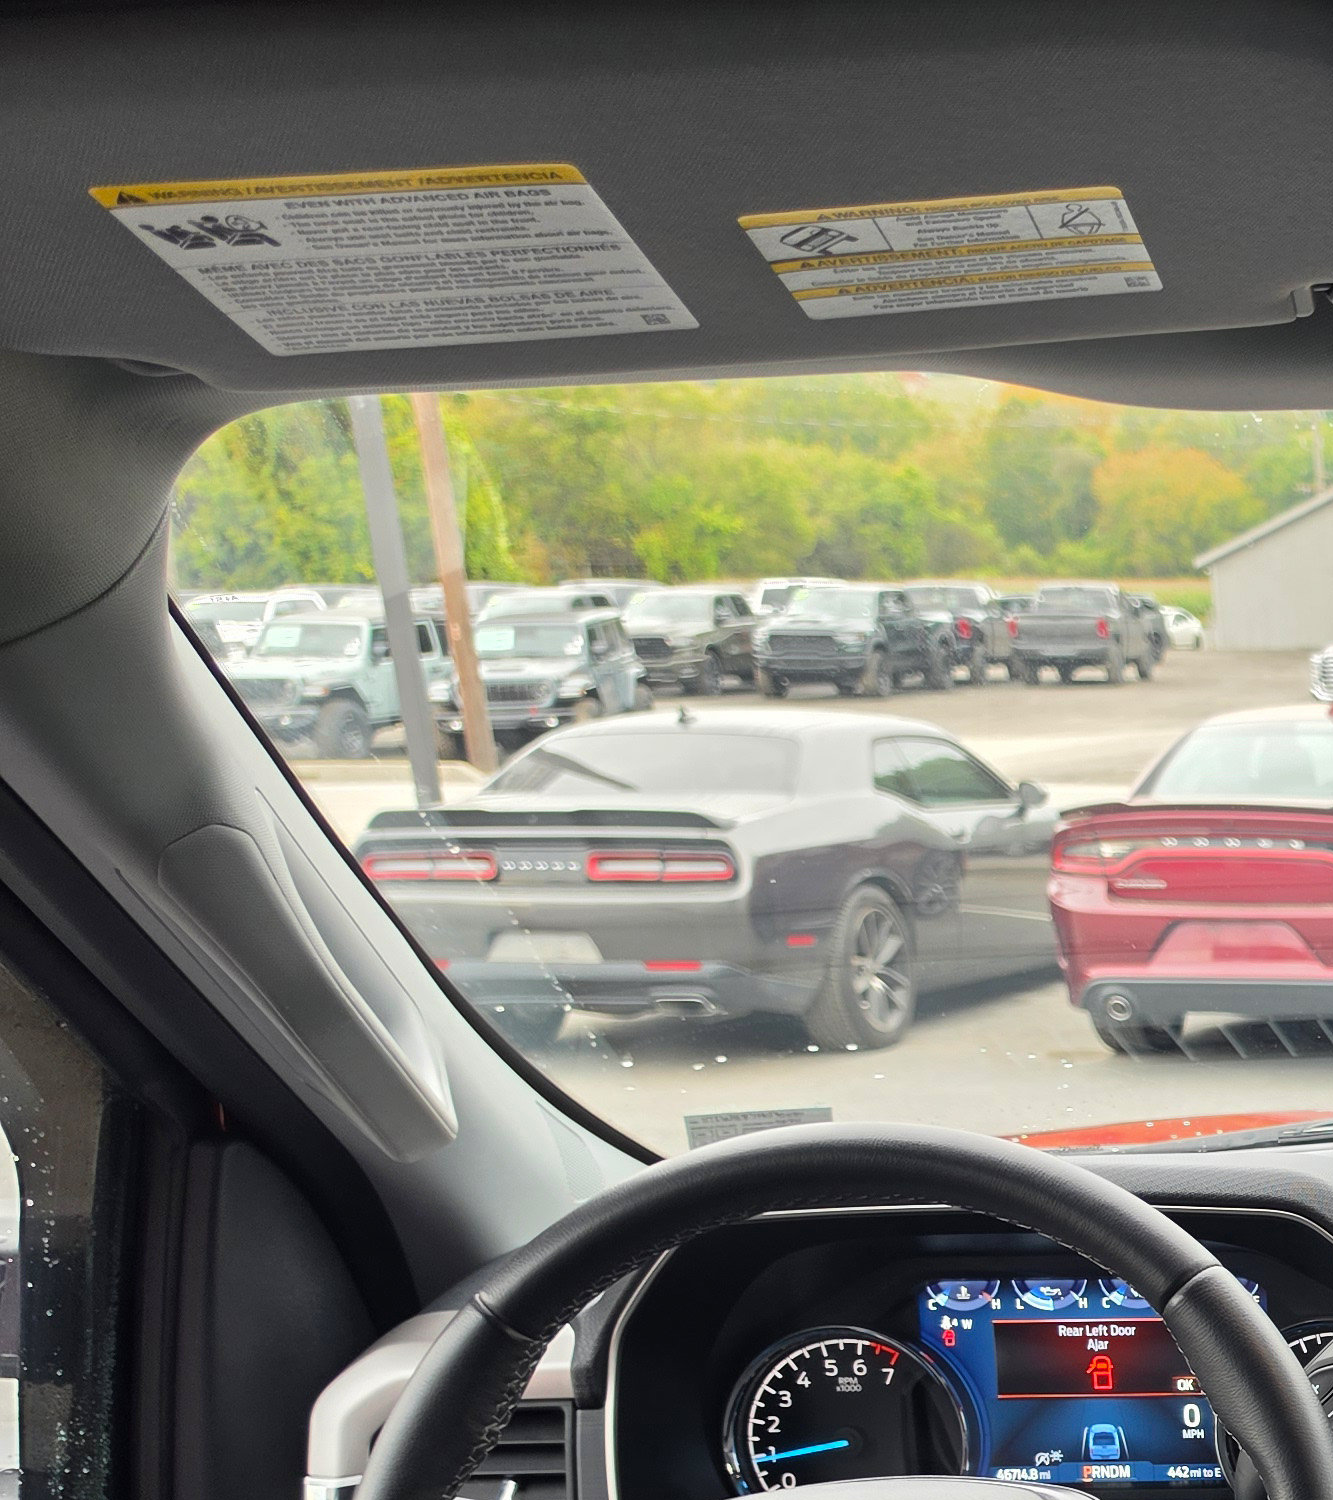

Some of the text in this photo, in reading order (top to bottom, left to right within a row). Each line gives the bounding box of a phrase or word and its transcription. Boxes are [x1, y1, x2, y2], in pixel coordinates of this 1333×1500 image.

[281, 188, 552, 210] EVEN WITH ADVANCED AIR BAGS
[1058, 1324, 1136, 1337] Rear Left Door
[1087, 1338, 1110, 1352] Ajar
[824, 1359, 839, 1377] 5
[853, 1358, 868, 1377] 6
[796, 1371, 812, 1389] 4
[881, 1368, 895, 1386] 7
[1177, 1379, 1194, 1391] OK
[778, 1390, 793, 1408] 3
[767, 1415, 781, 1433] 2
[1183, 1403, 1201, 1428] 0
[1182, 1428, 1205, 1440] MPH
[781, 1472, 796, 1490] 0
[1167, 1466, 1189, 1479] 442
[1202, 1467, 1213, 1478] to
